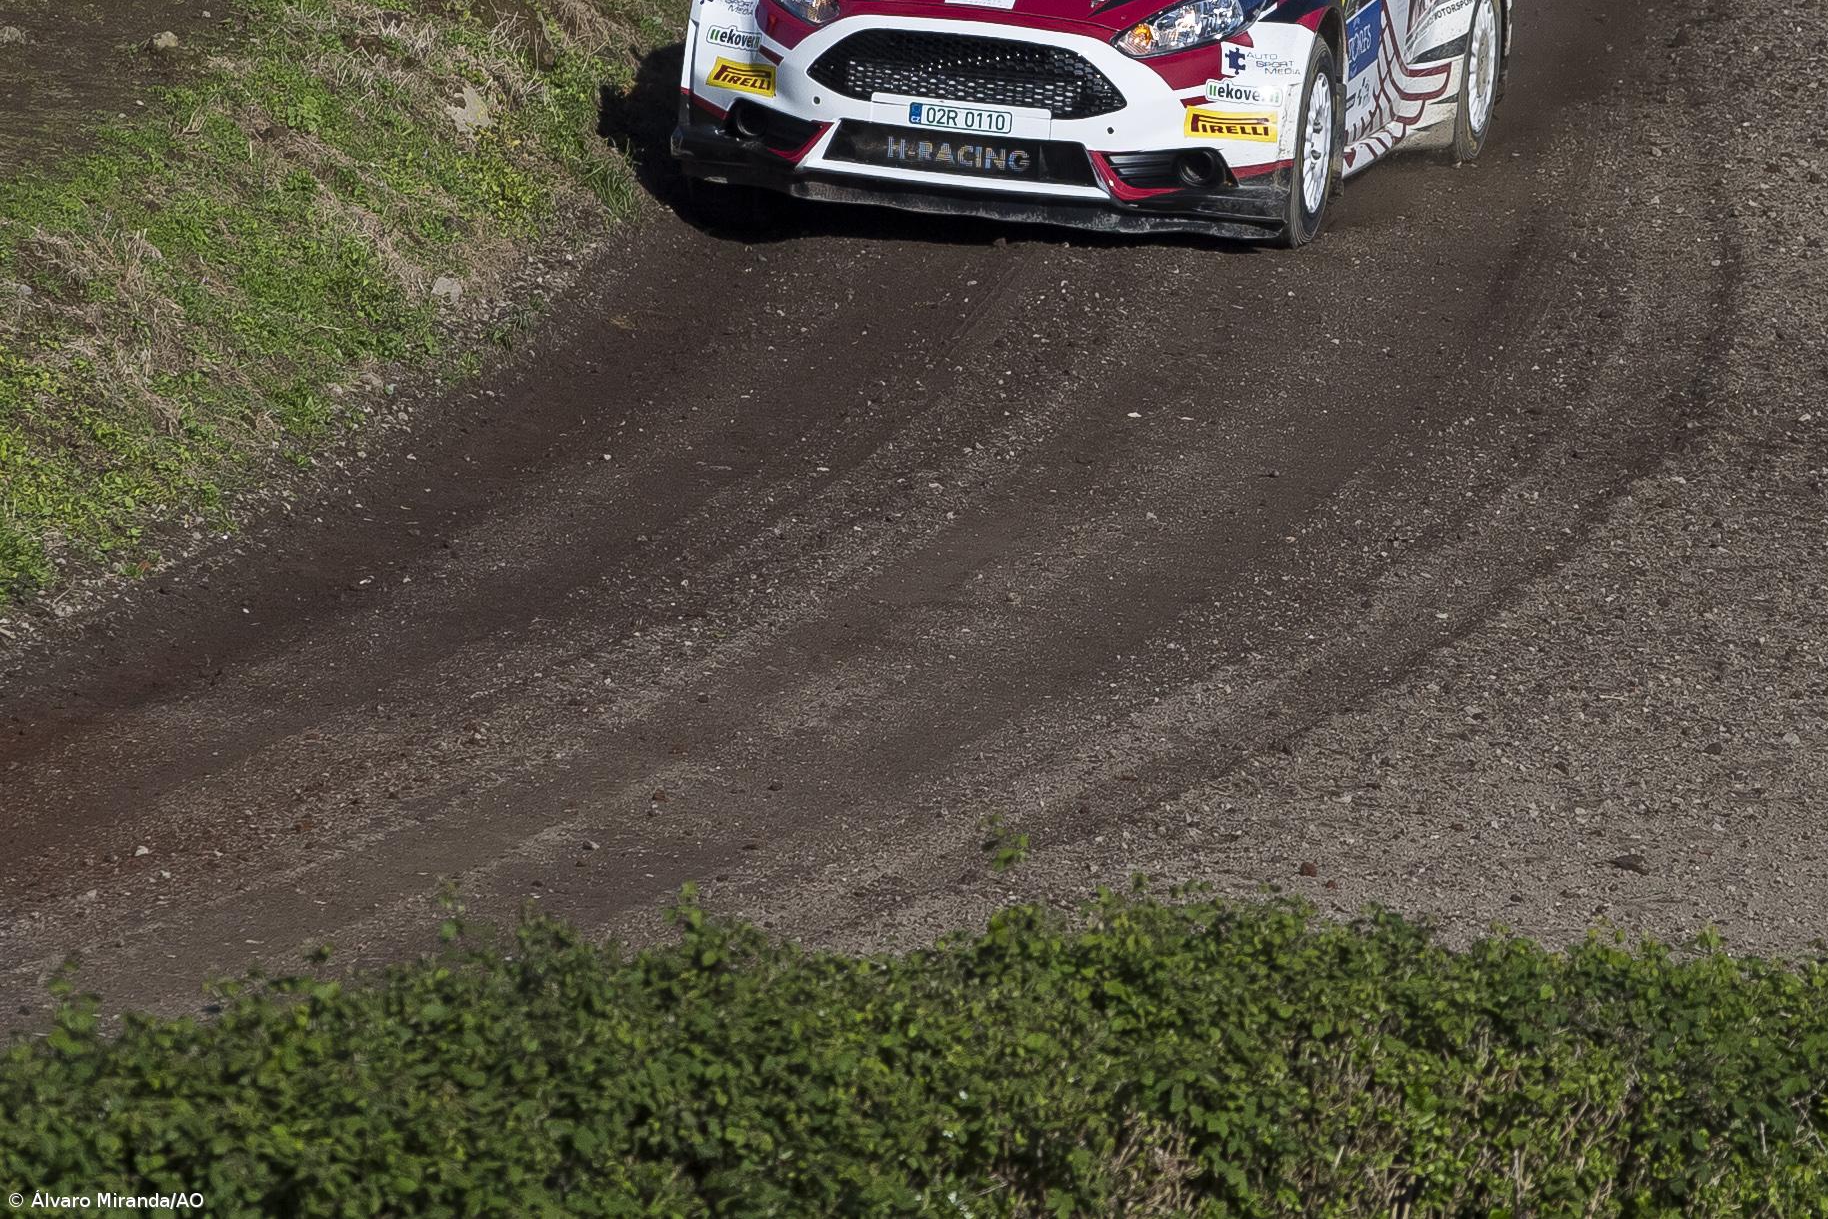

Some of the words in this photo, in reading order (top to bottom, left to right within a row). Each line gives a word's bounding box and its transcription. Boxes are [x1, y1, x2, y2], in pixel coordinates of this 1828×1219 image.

[1246, 51, 1278, 60] AUTO
[713, 64, 772, 91] PIRELLI
[926, 107, 958, 126] 02R
[964, 111, 1005, 131] 0110
[1190, 113, 1270, 137] PIRELLI
[887, 136, 1031, 173] H-RACING
